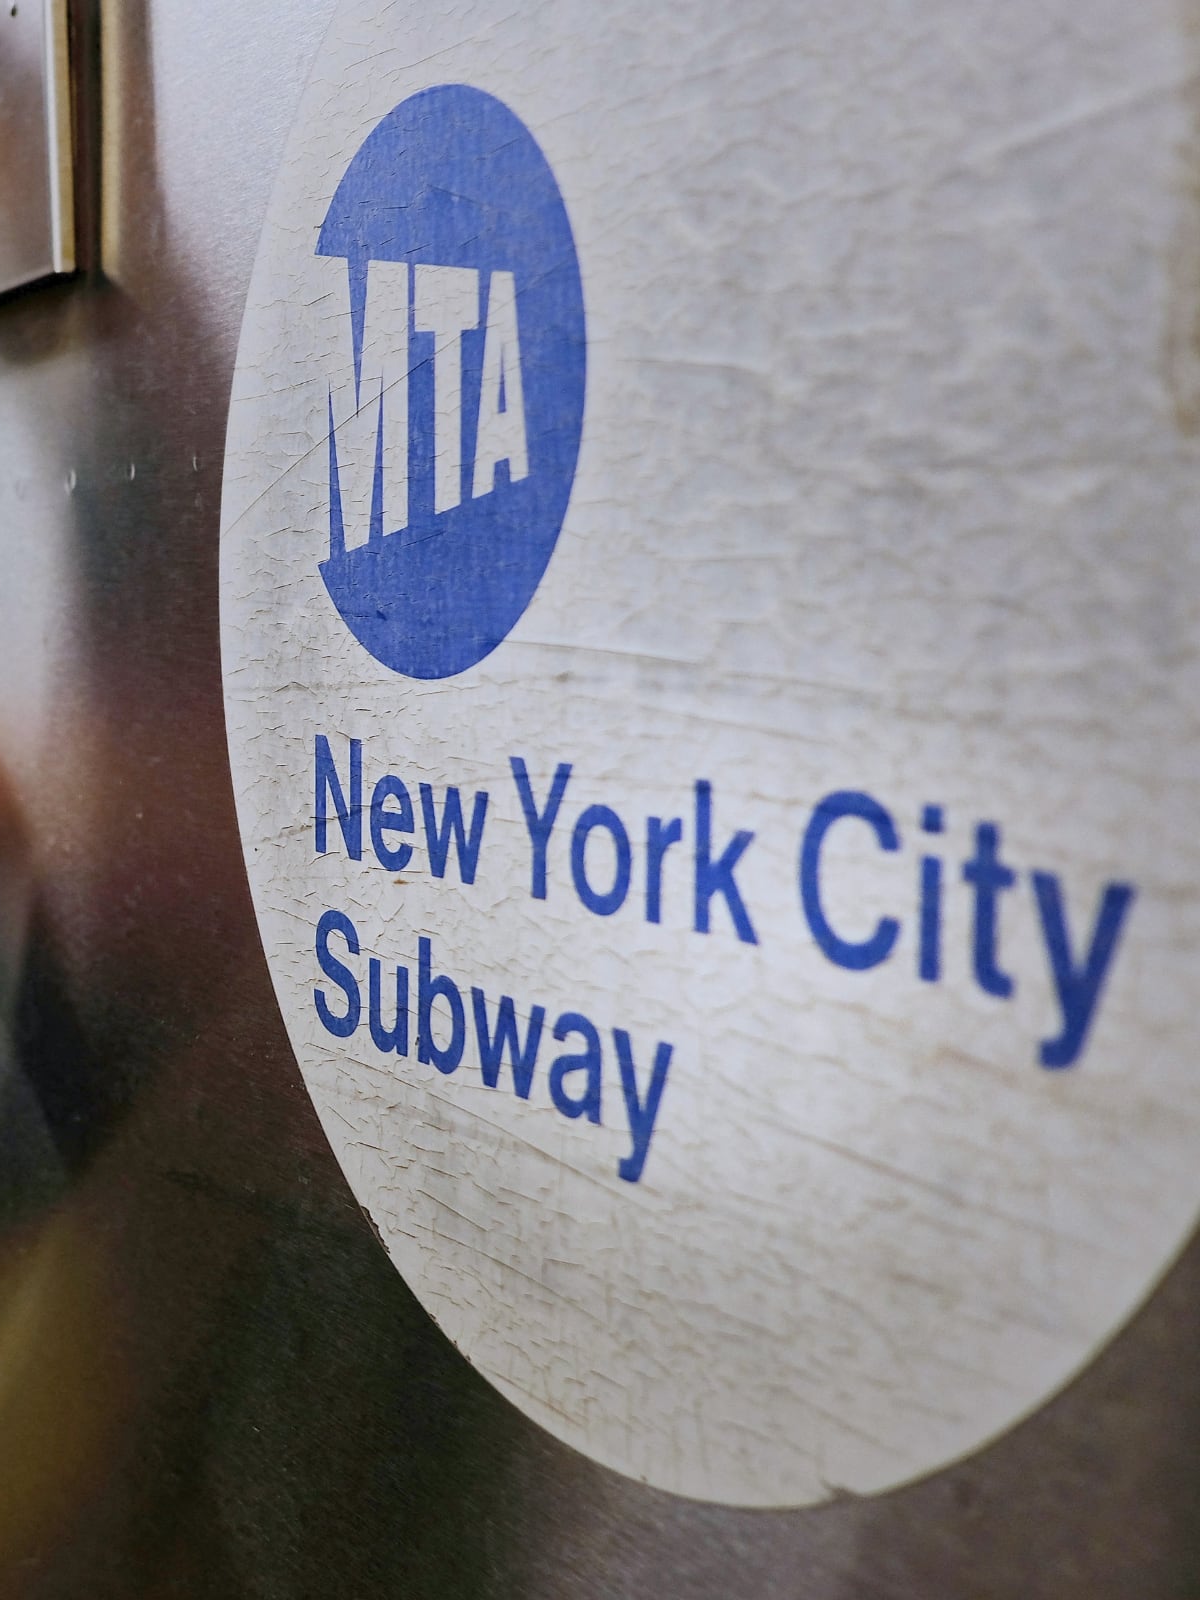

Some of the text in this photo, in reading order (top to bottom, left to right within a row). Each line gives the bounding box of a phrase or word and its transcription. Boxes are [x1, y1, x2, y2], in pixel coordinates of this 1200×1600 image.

[316, 255, 529, 553] MTA
[313, 909, 675, 1183] Subway
[314, 734, 1133, 1069] New York City
